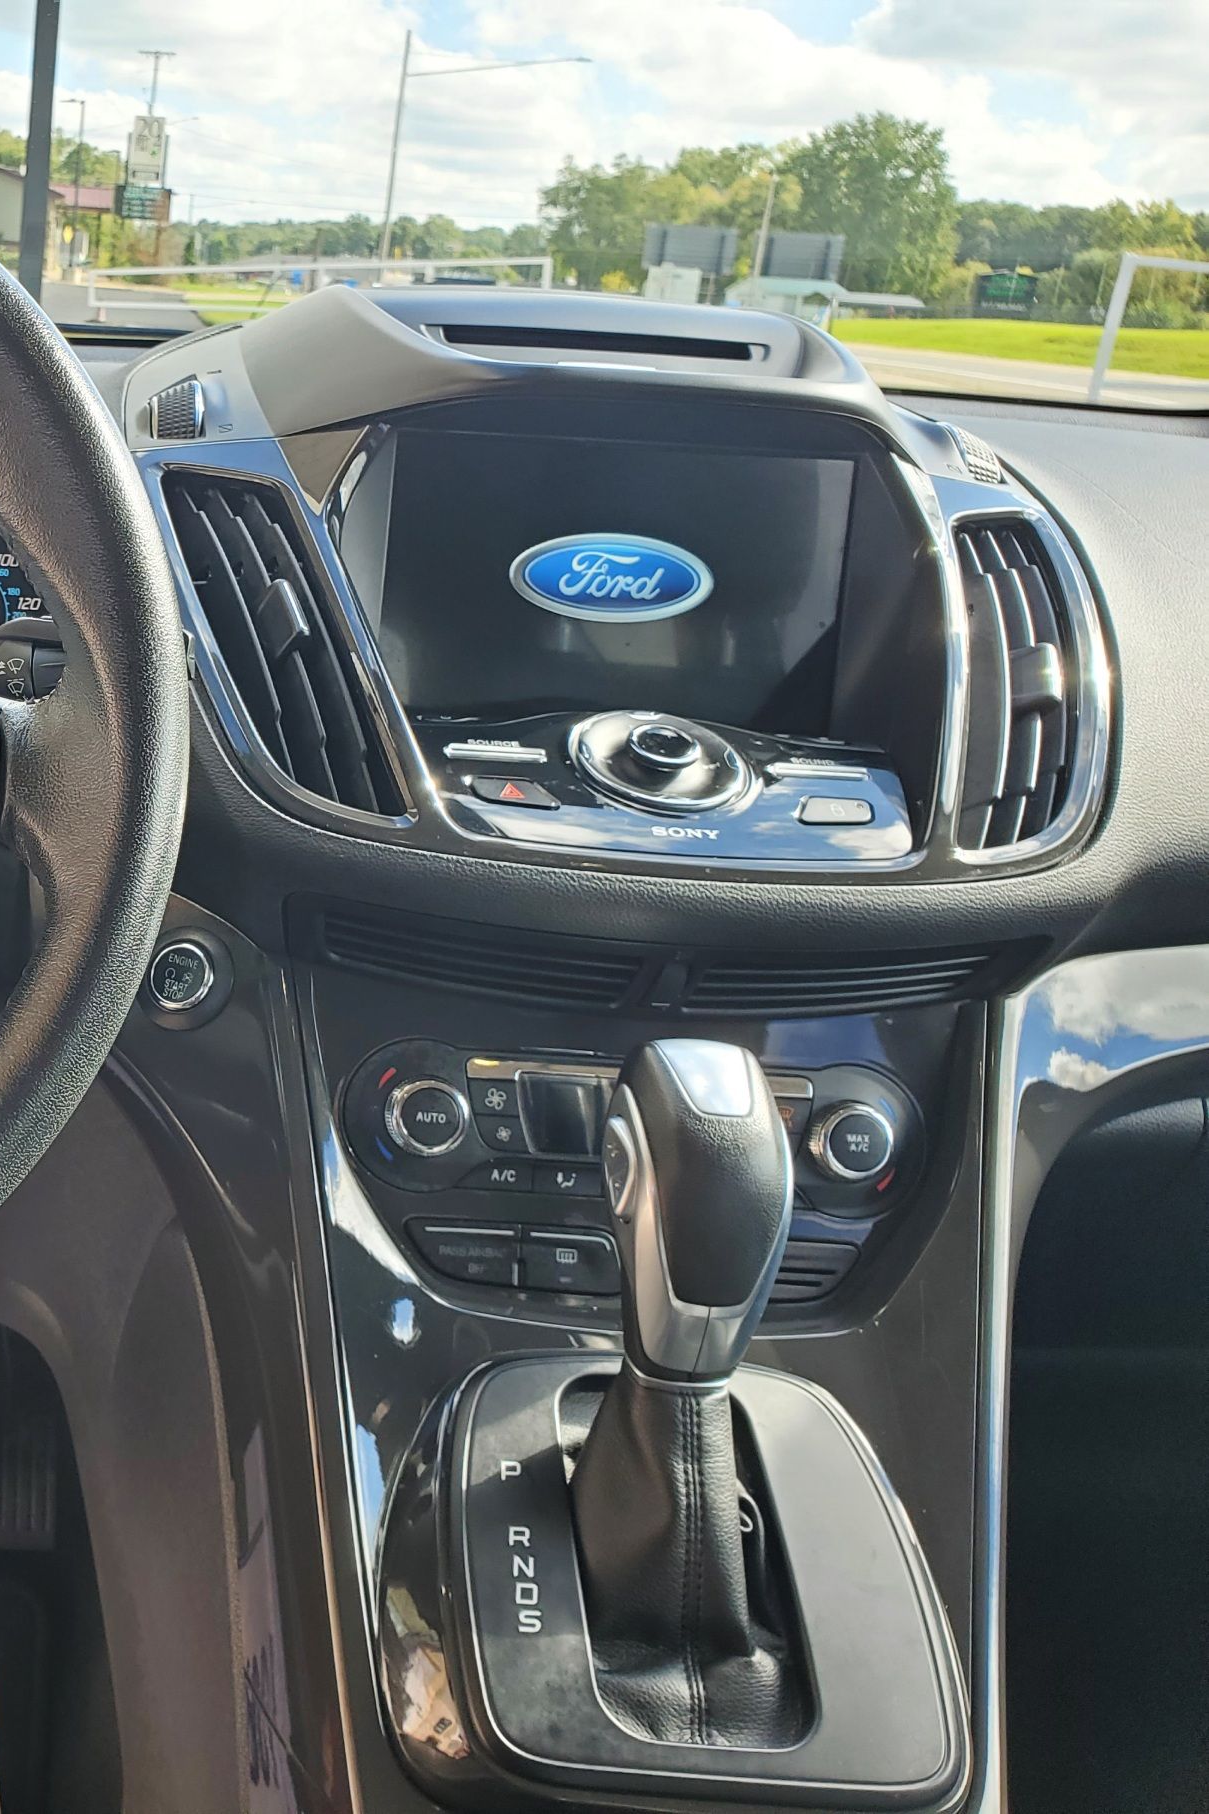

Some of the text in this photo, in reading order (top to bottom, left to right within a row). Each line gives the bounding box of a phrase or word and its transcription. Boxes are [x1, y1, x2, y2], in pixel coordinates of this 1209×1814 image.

[558, 551, 665, 600] Ford
[17, 596, 42, 610] 120
[651, 825, 720, 840] SONY
[168, 953, 198, 970] ENGINE
[164, 978, 188, 992] START
[162, 987, 184, 1000] STOP
[416, 1112, 447, 1124] AUTO
[846, 1133, 870, 1143] MAX
[850, 1143, 870, 1152] A/C
[491, 1169, 517, 1183] A/C
[500, 1459, 522, 1481] P
[508, 1525, 531, 1547] R
[512, 1554, 535, 1578] N
[515, 1581, 539, 1605] D
[518, 1609, 542, 1633] S
